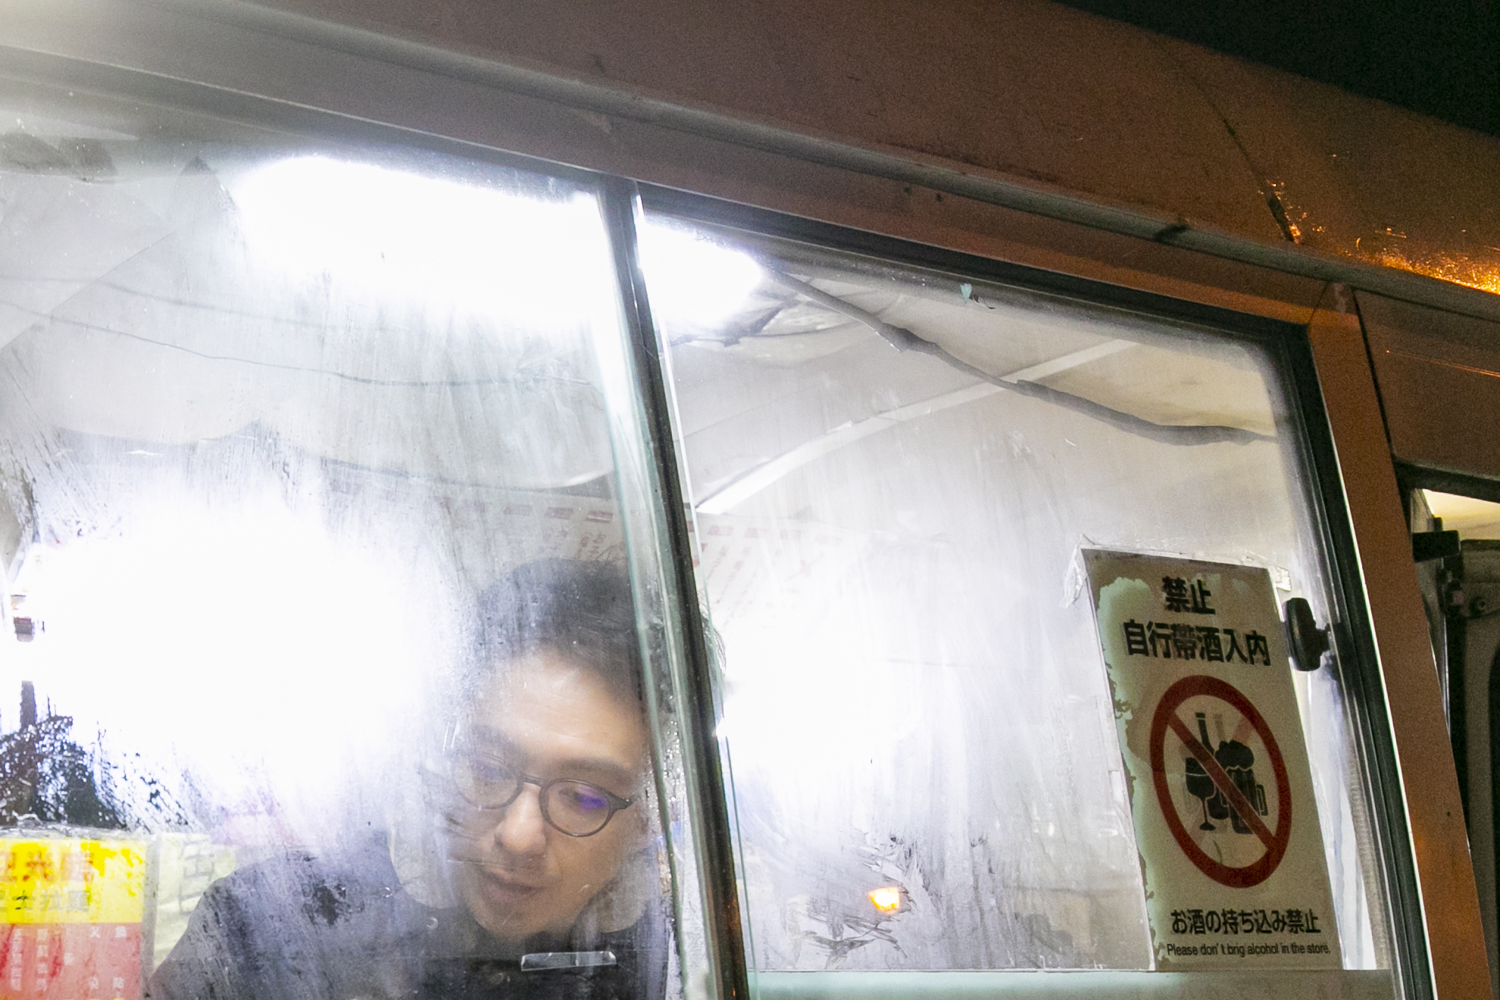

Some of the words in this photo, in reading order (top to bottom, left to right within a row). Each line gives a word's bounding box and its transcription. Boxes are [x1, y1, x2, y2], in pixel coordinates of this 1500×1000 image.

[1162, 575, 1216, 614] 禁止
[1171, 908, 1321, 935] お酒の持ち込み禁止
[1166, 943, 1198, 956] Please
[1247, 942, 1279, 955] alcohol
[1280, 942, 1290, 955] in
[1291, 942, 1305, 954] the
